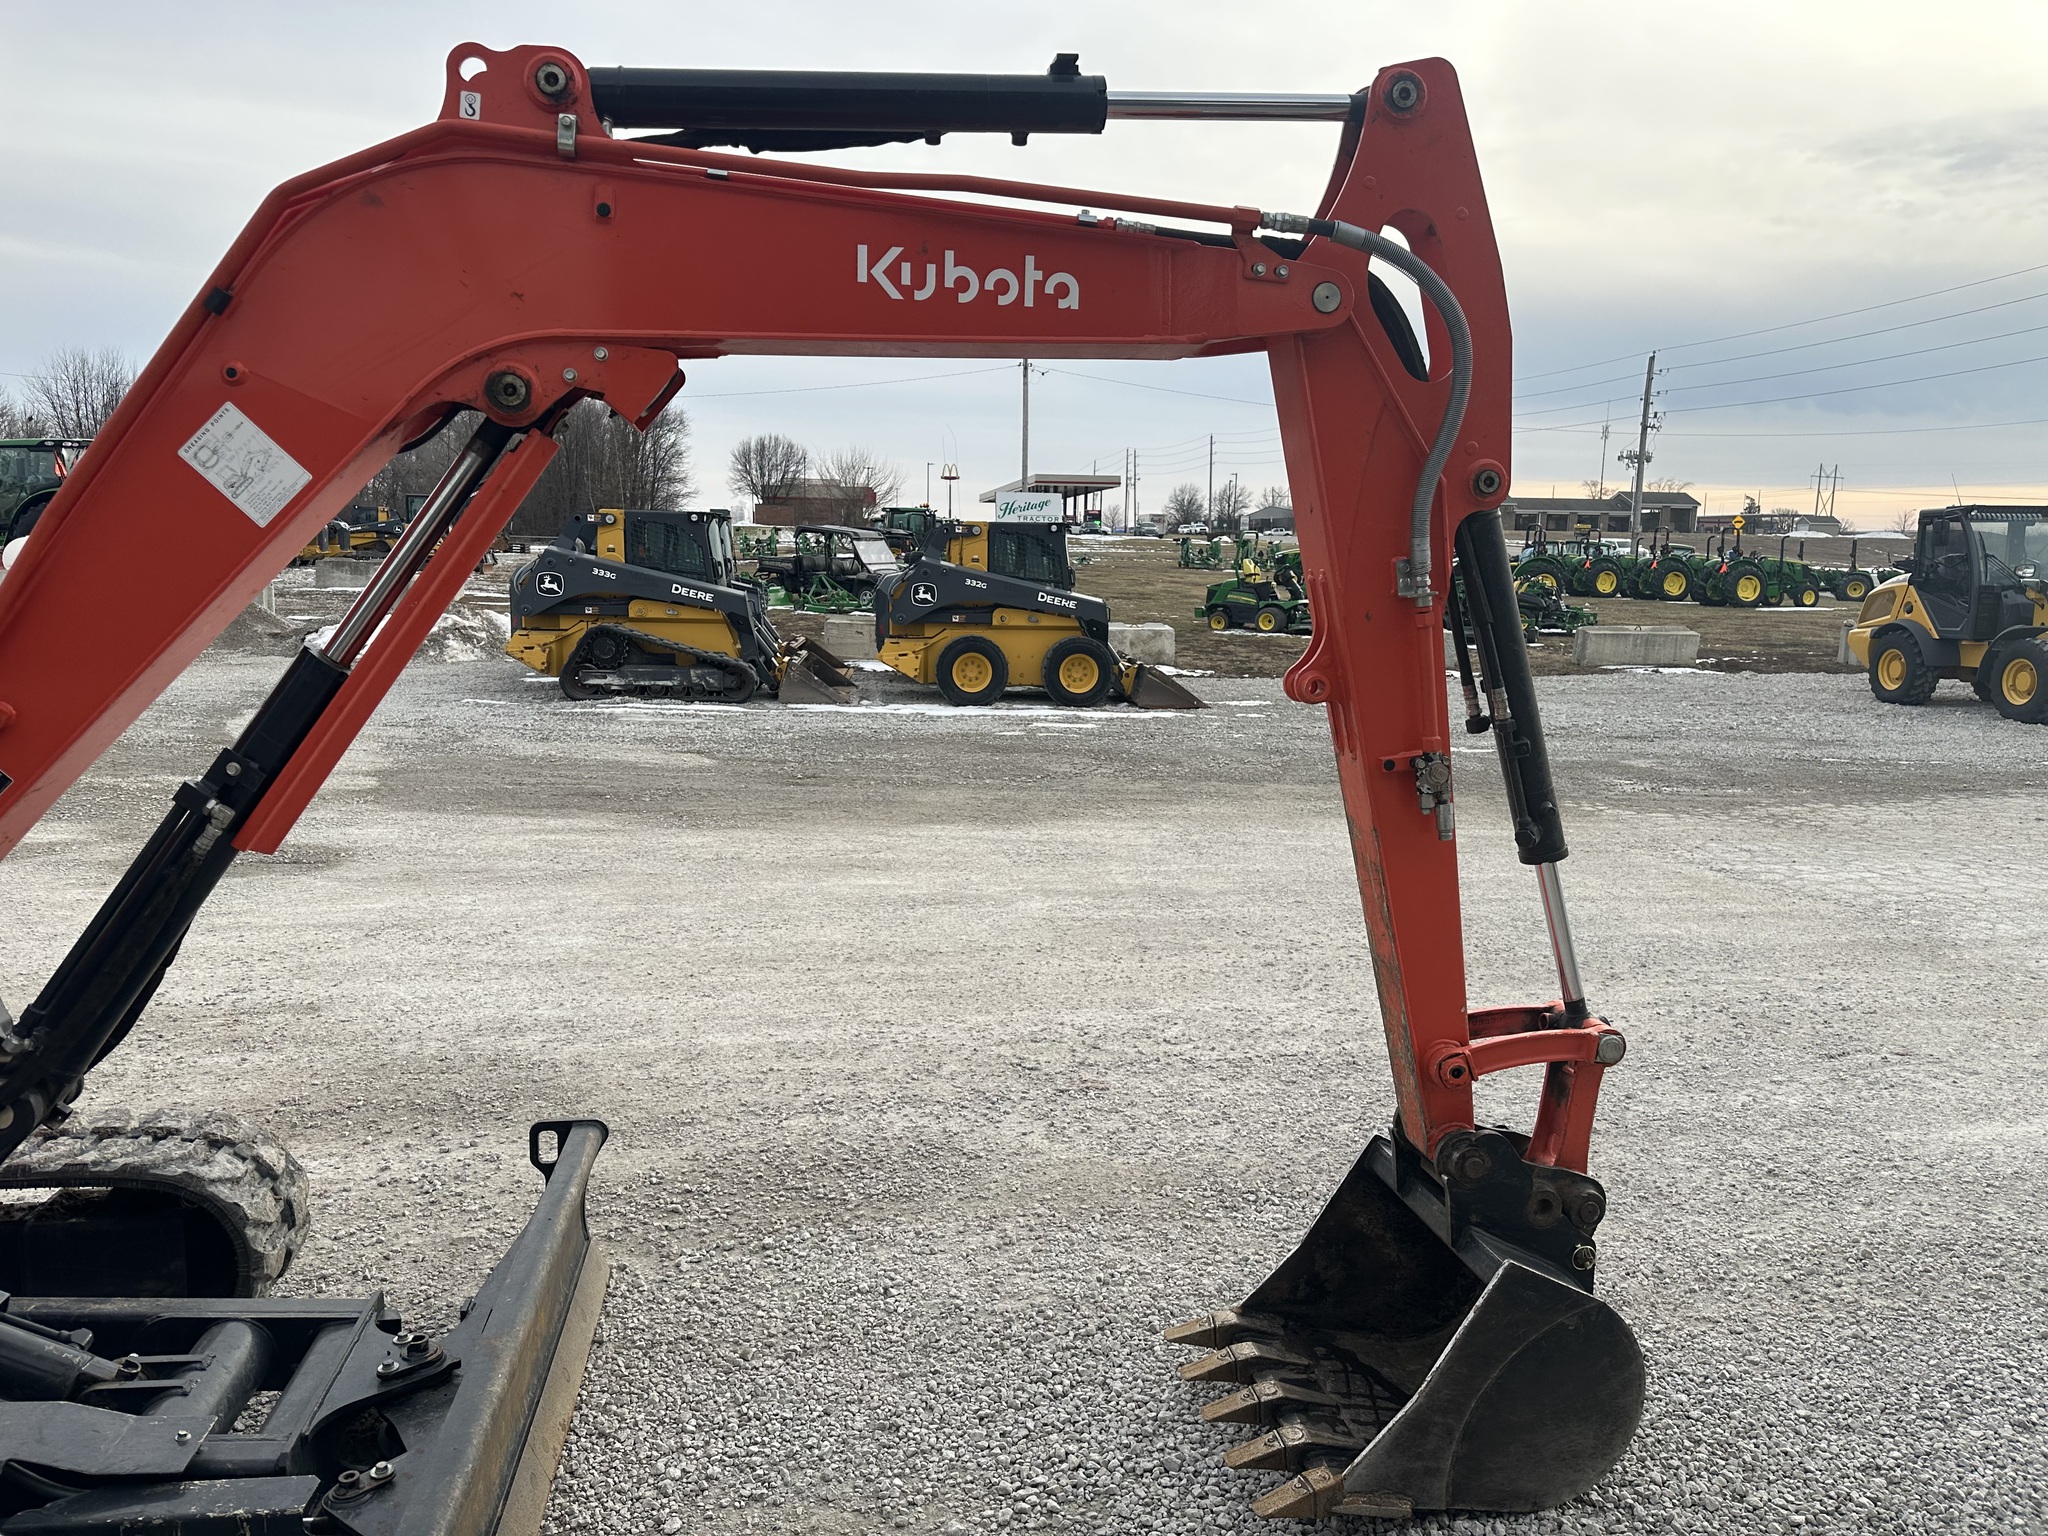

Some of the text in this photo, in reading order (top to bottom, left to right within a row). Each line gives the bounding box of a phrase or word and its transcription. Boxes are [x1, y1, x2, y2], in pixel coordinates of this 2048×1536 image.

[857, 244, 1080, 310] Kubota
[184, 407, 230, 454] GREASING POINTS
[997, 499, 1051, 520] Heritage
[591, 567, 617, 580] 333G
[671, 583, 715, 602] DEERE
[964, 578, 988, 589] 332G
[1037, 592, 1078, 609] DEERE
